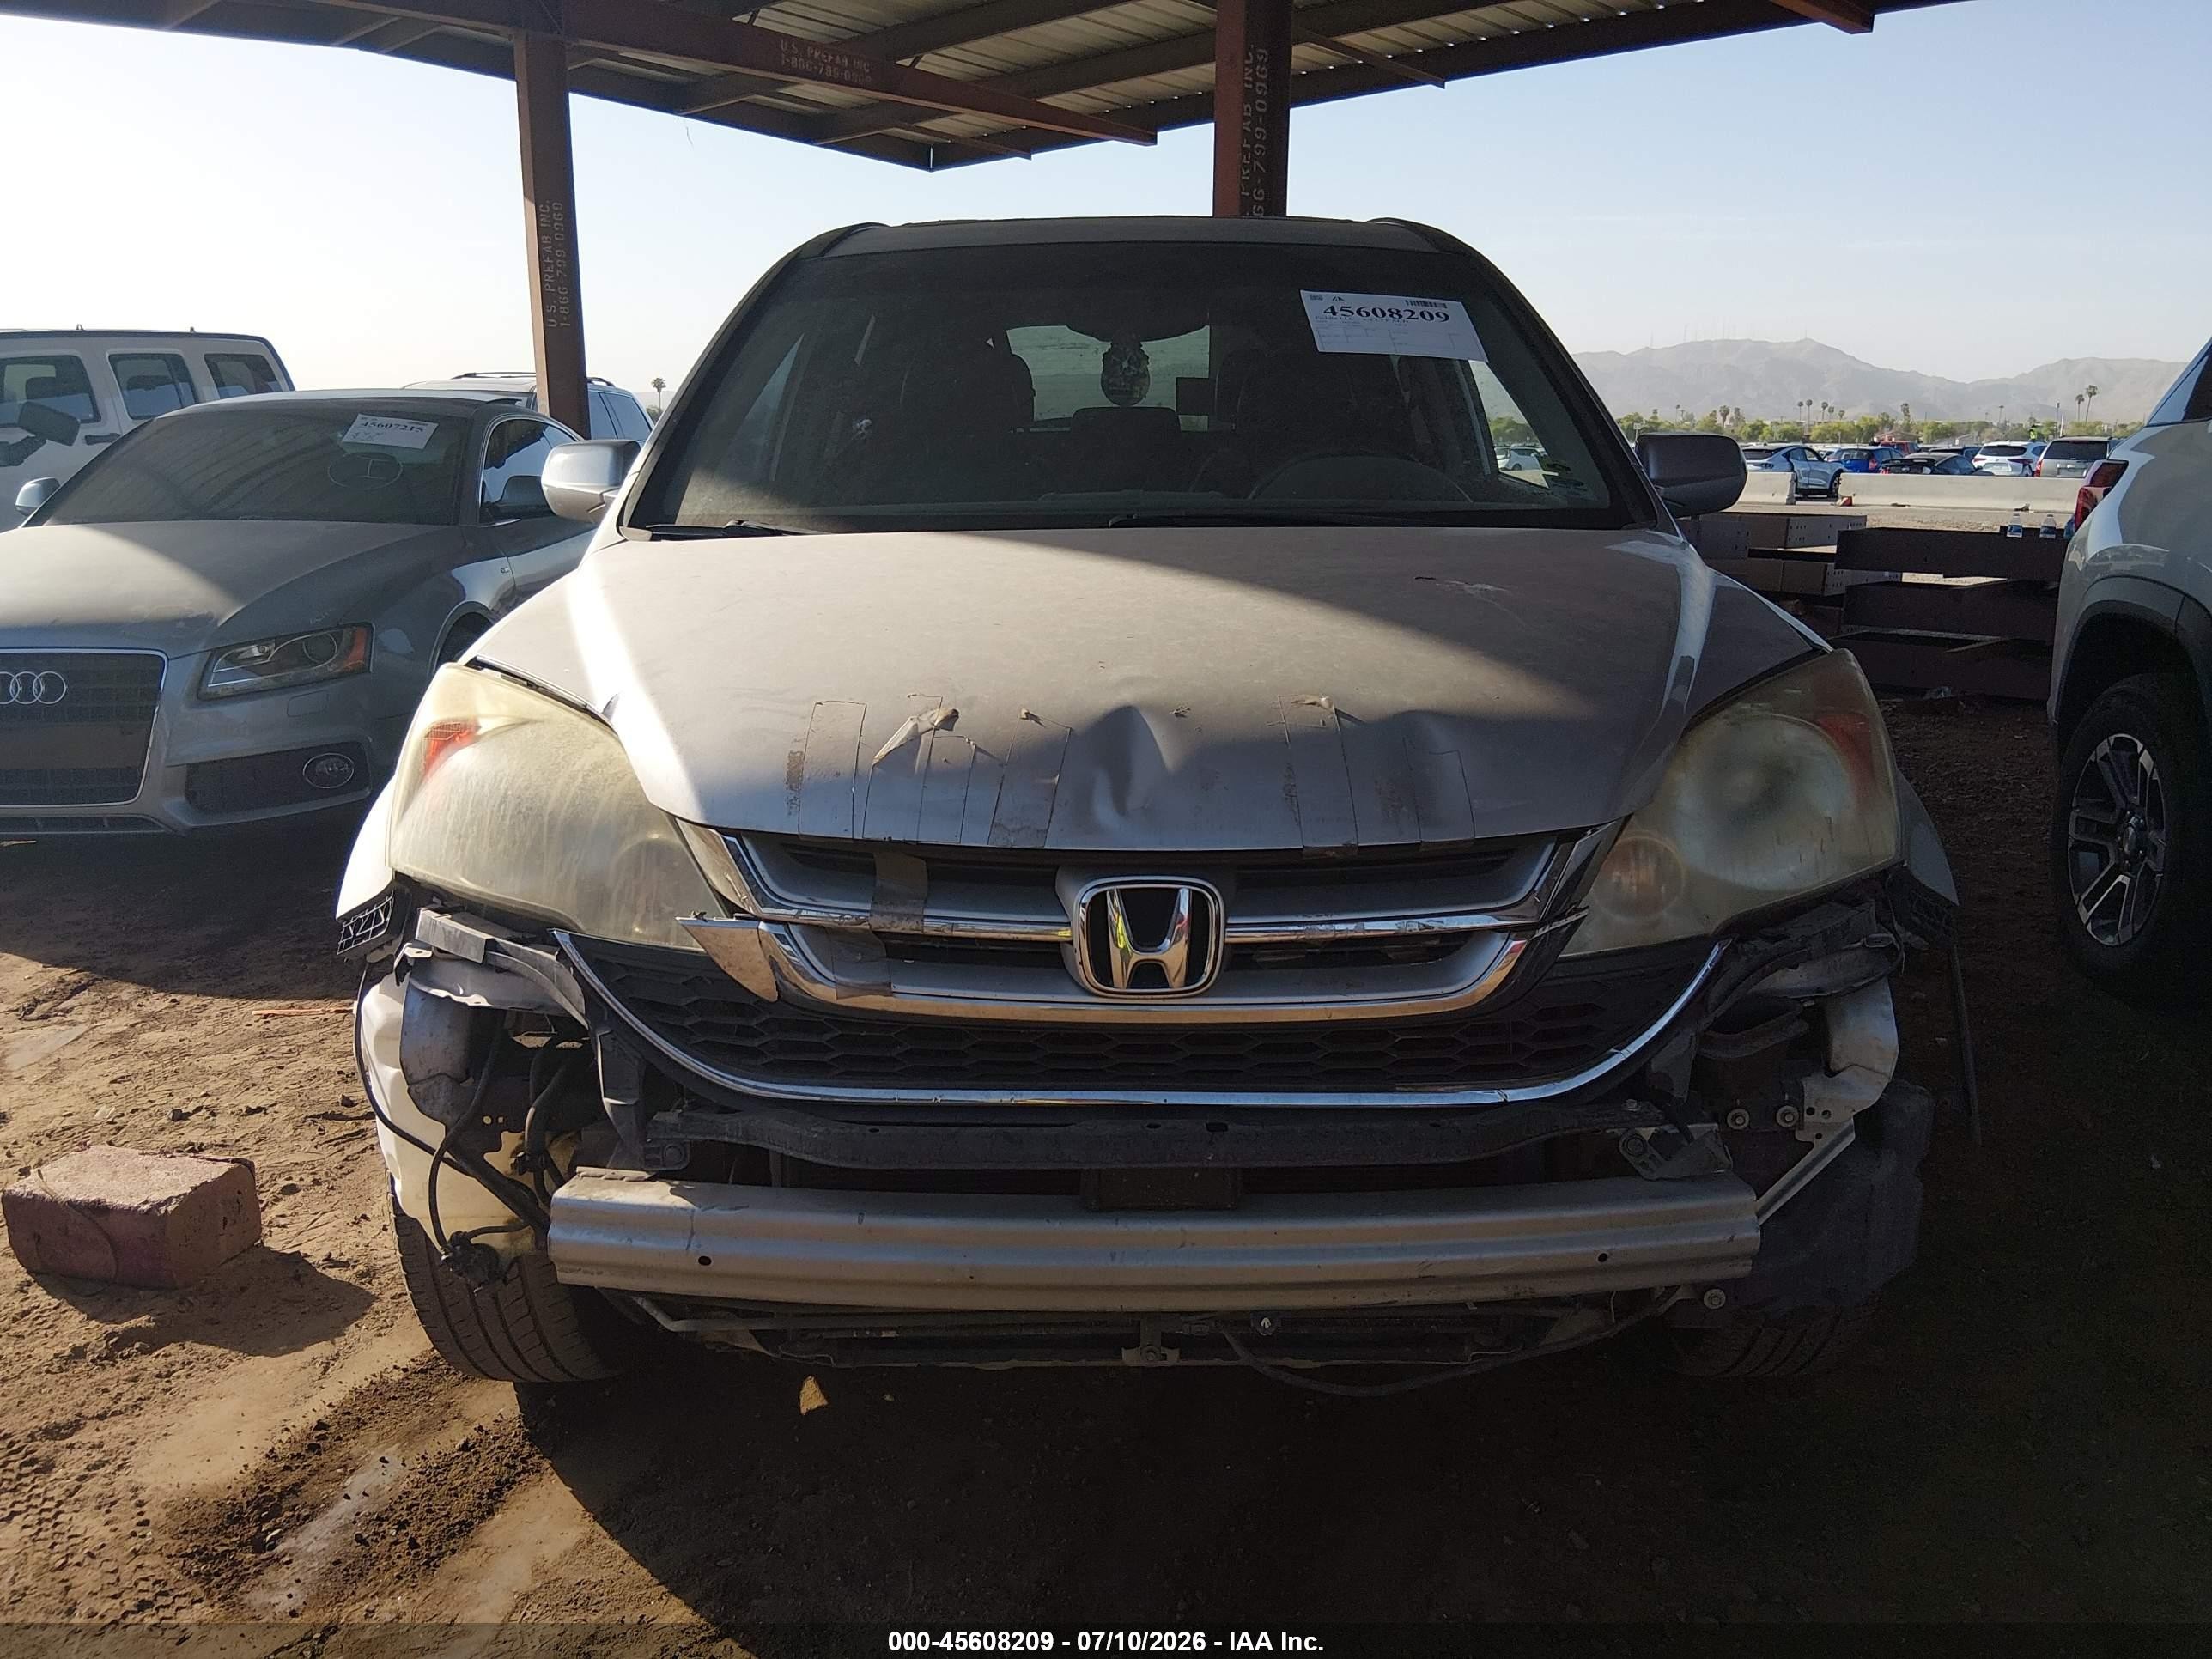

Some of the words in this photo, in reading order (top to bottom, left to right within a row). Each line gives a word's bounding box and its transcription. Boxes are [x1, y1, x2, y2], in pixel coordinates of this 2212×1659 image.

[1253, 48, 1269, 218] 66-799-0969
[542, 234, 556, 292] PREFAB
[1323, 305, 1450, 323] 45608209
